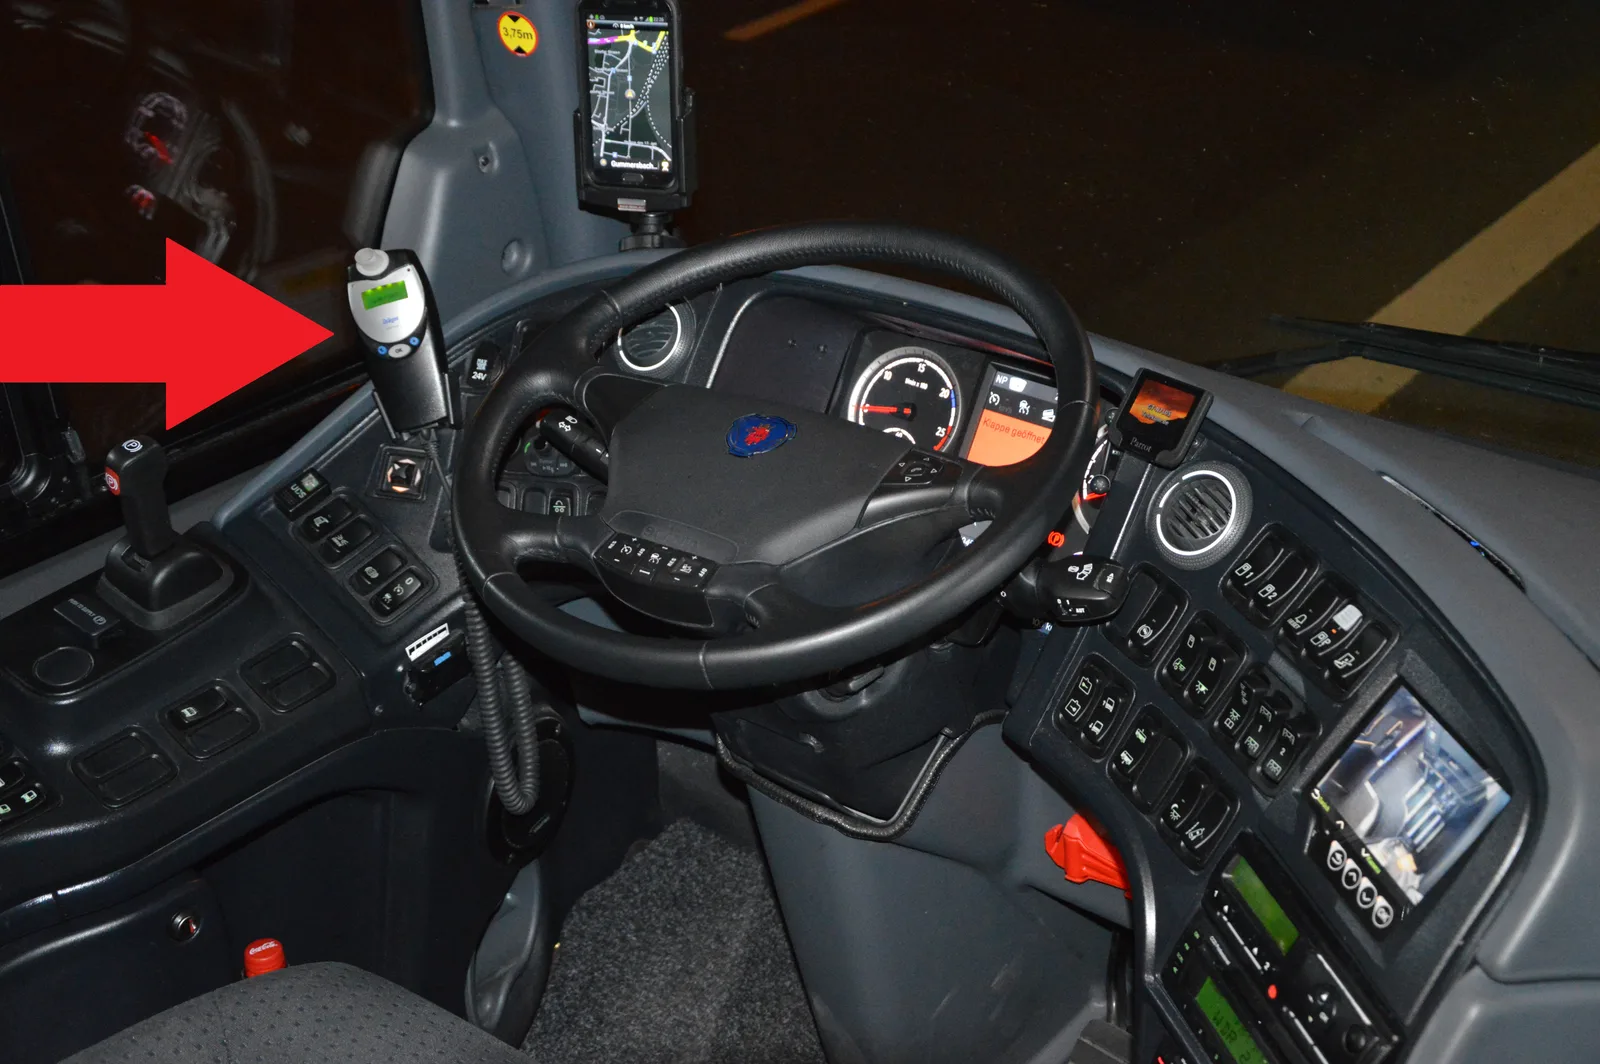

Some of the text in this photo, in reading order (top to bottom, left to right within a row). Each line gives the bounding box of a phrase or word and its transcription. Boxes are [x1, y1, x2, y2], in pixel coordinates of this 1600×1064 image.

[502, 27, 533, 40] 3,75m
[917, 363, 926, 373] 15
[471, 371, 488, 381] 24V
[883, 370, 893, 381] 10
[995, 374, 1009, 384] NP
[939, 387, 950, 398] 20
[935, 426, 946, 438] 25
[983, 417, 1045, 444] Klappe geöffnet
[1129, 437, 1153, 453] Parrot
[607, 540, 617, 550] RES
[666, 557, 677, 567] RES
[1267, 591, 1278, 600] 2
[1258, 724, 1263, 733] 1
[1280, 747, 1286, 757] 2
[1214, 890, 1219, 898] 1
[1378, 909, 1391, 923] OK
[249, 941, 278, 955] Coca-Cola
[1263, 961, 1271, 971] 2
